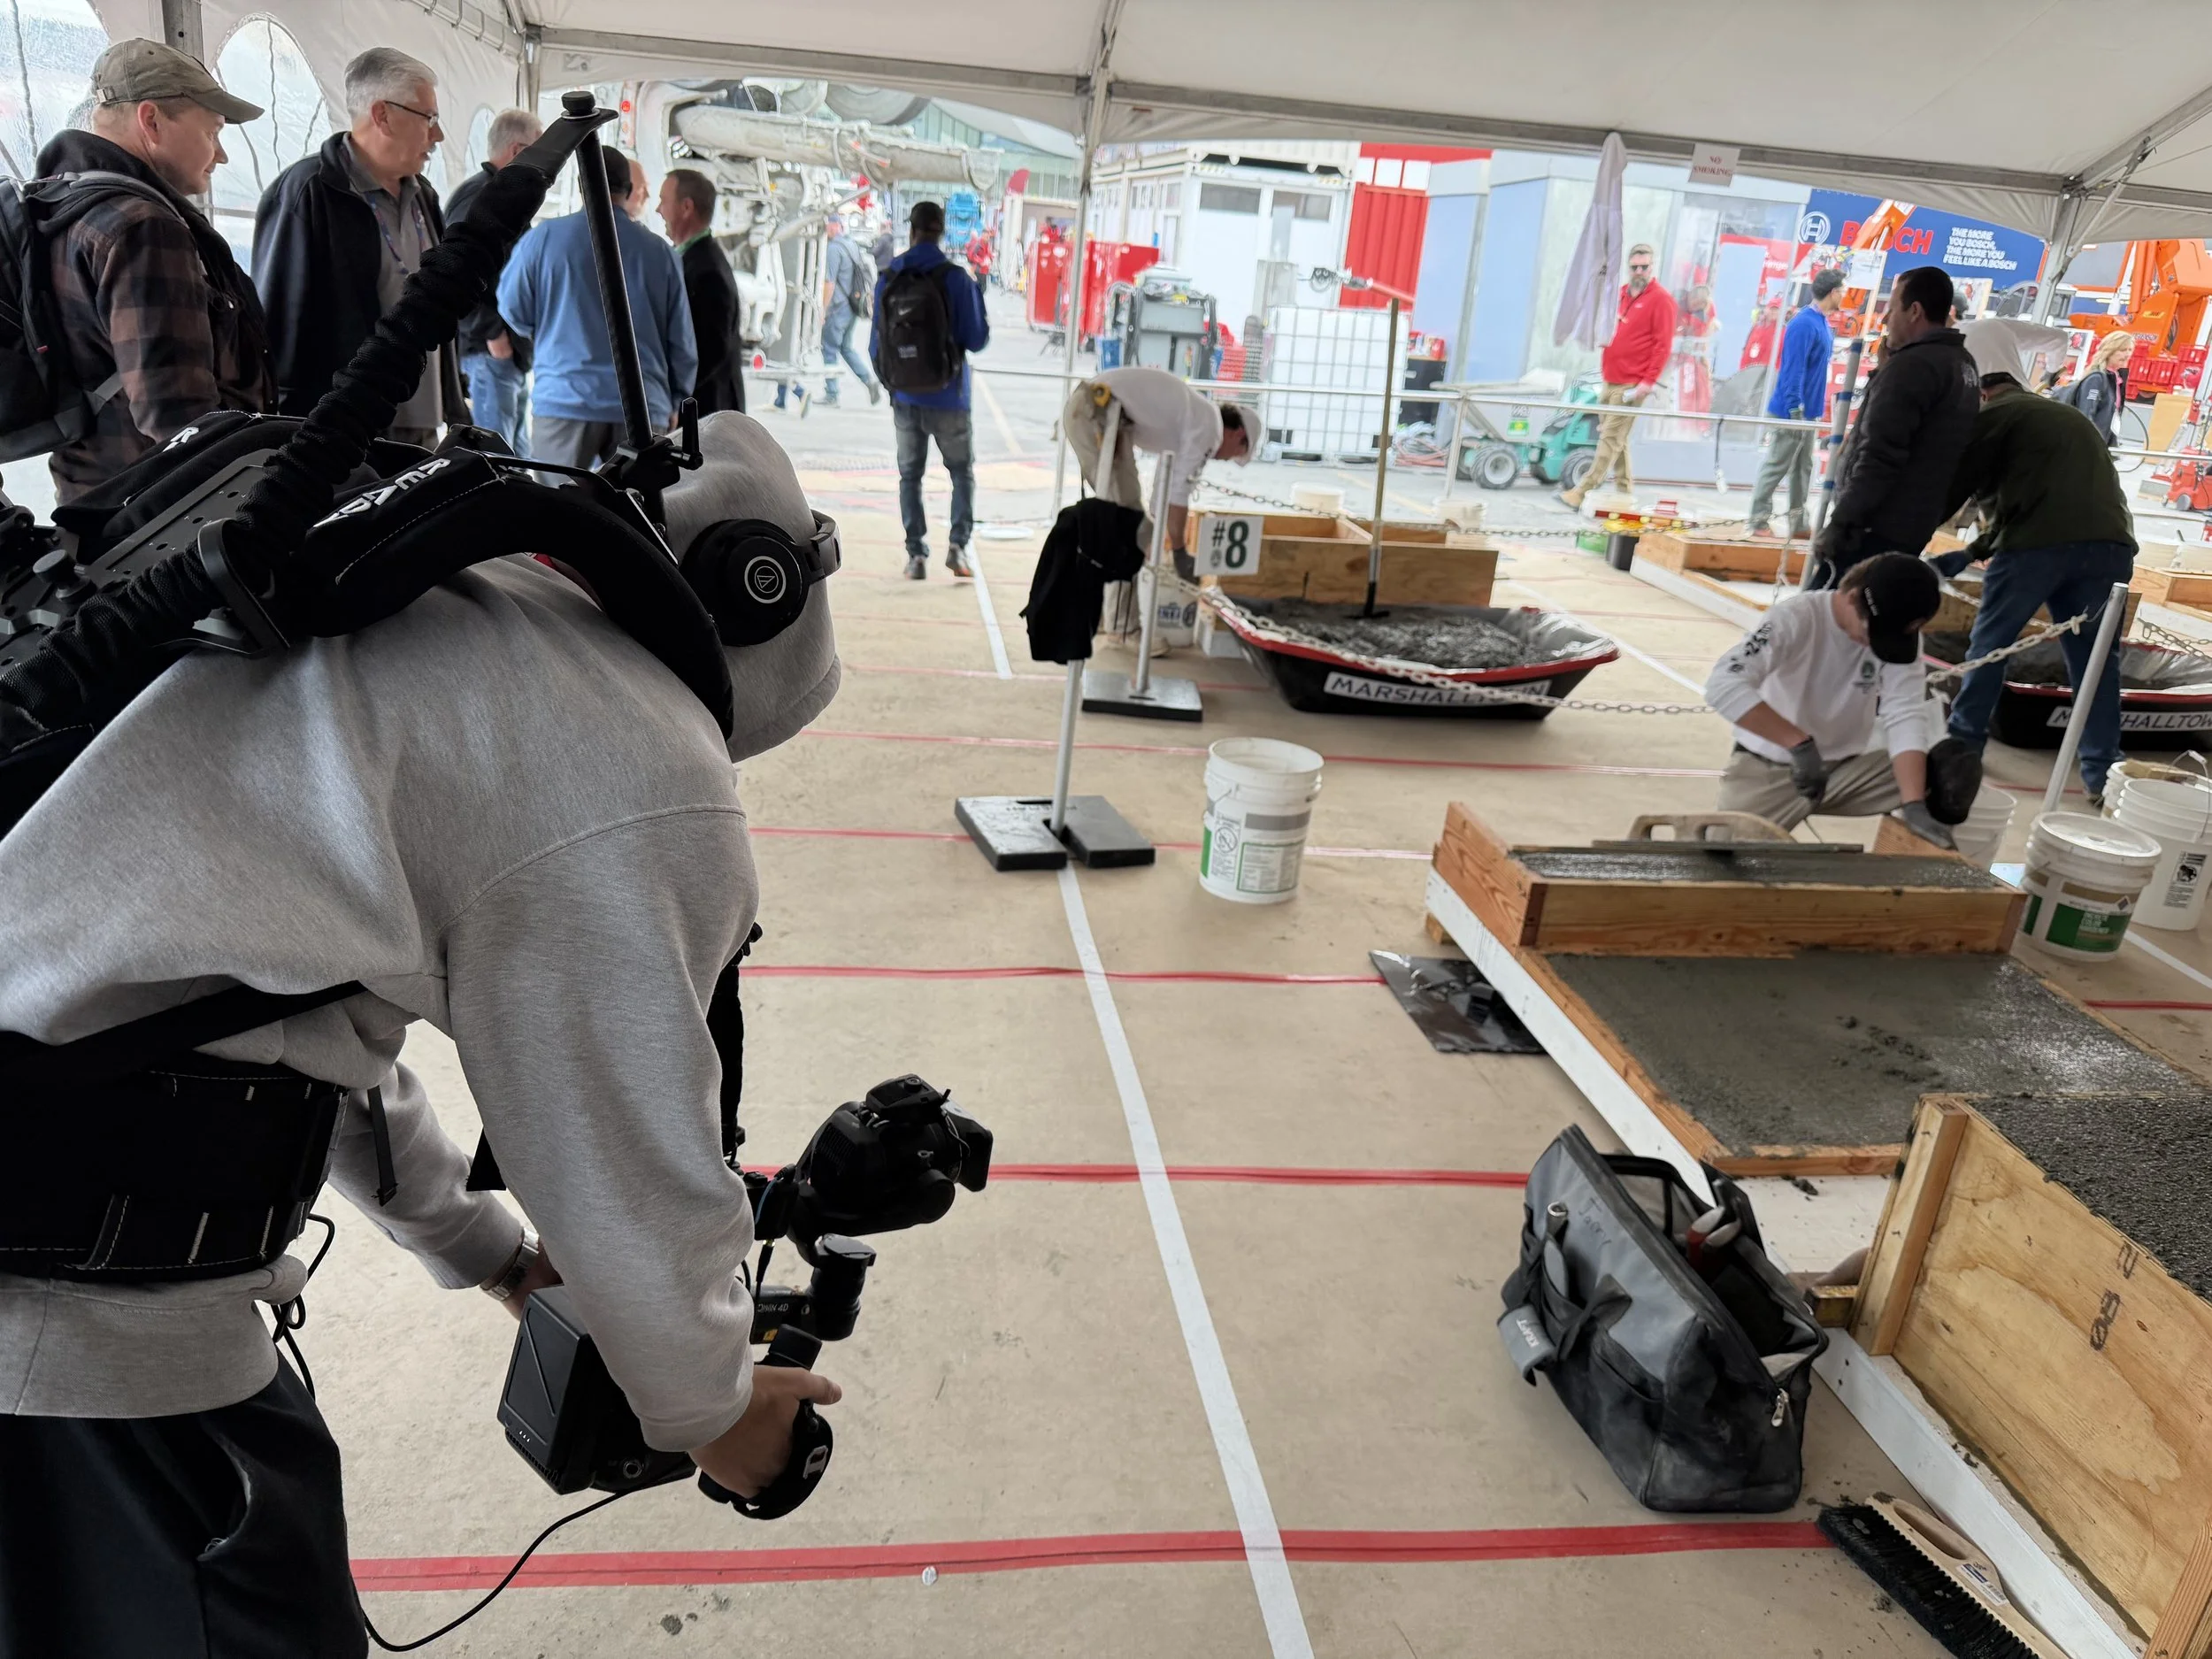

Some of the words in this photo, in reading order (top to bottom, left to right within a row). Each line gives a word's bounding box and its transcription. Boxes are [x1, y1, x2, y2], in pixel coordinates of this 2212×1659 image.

[1693, 165, 1733, 177] SMOKING
[1839, 220, 1934, 255] BCH
[1949, 236, 1966, 247] YOU
[1952, 227, 1968, 238] THE
[1968, 228, 1994, 241] MORE
[1947, 244, 1962, 255] THE
[1962, 247, 1988, 257] MORE
[1987, 250, 2005, 260] YOU
[313, 458, 451, 527] READY
[1516, 1318, 1540, 1348] KRAFT
